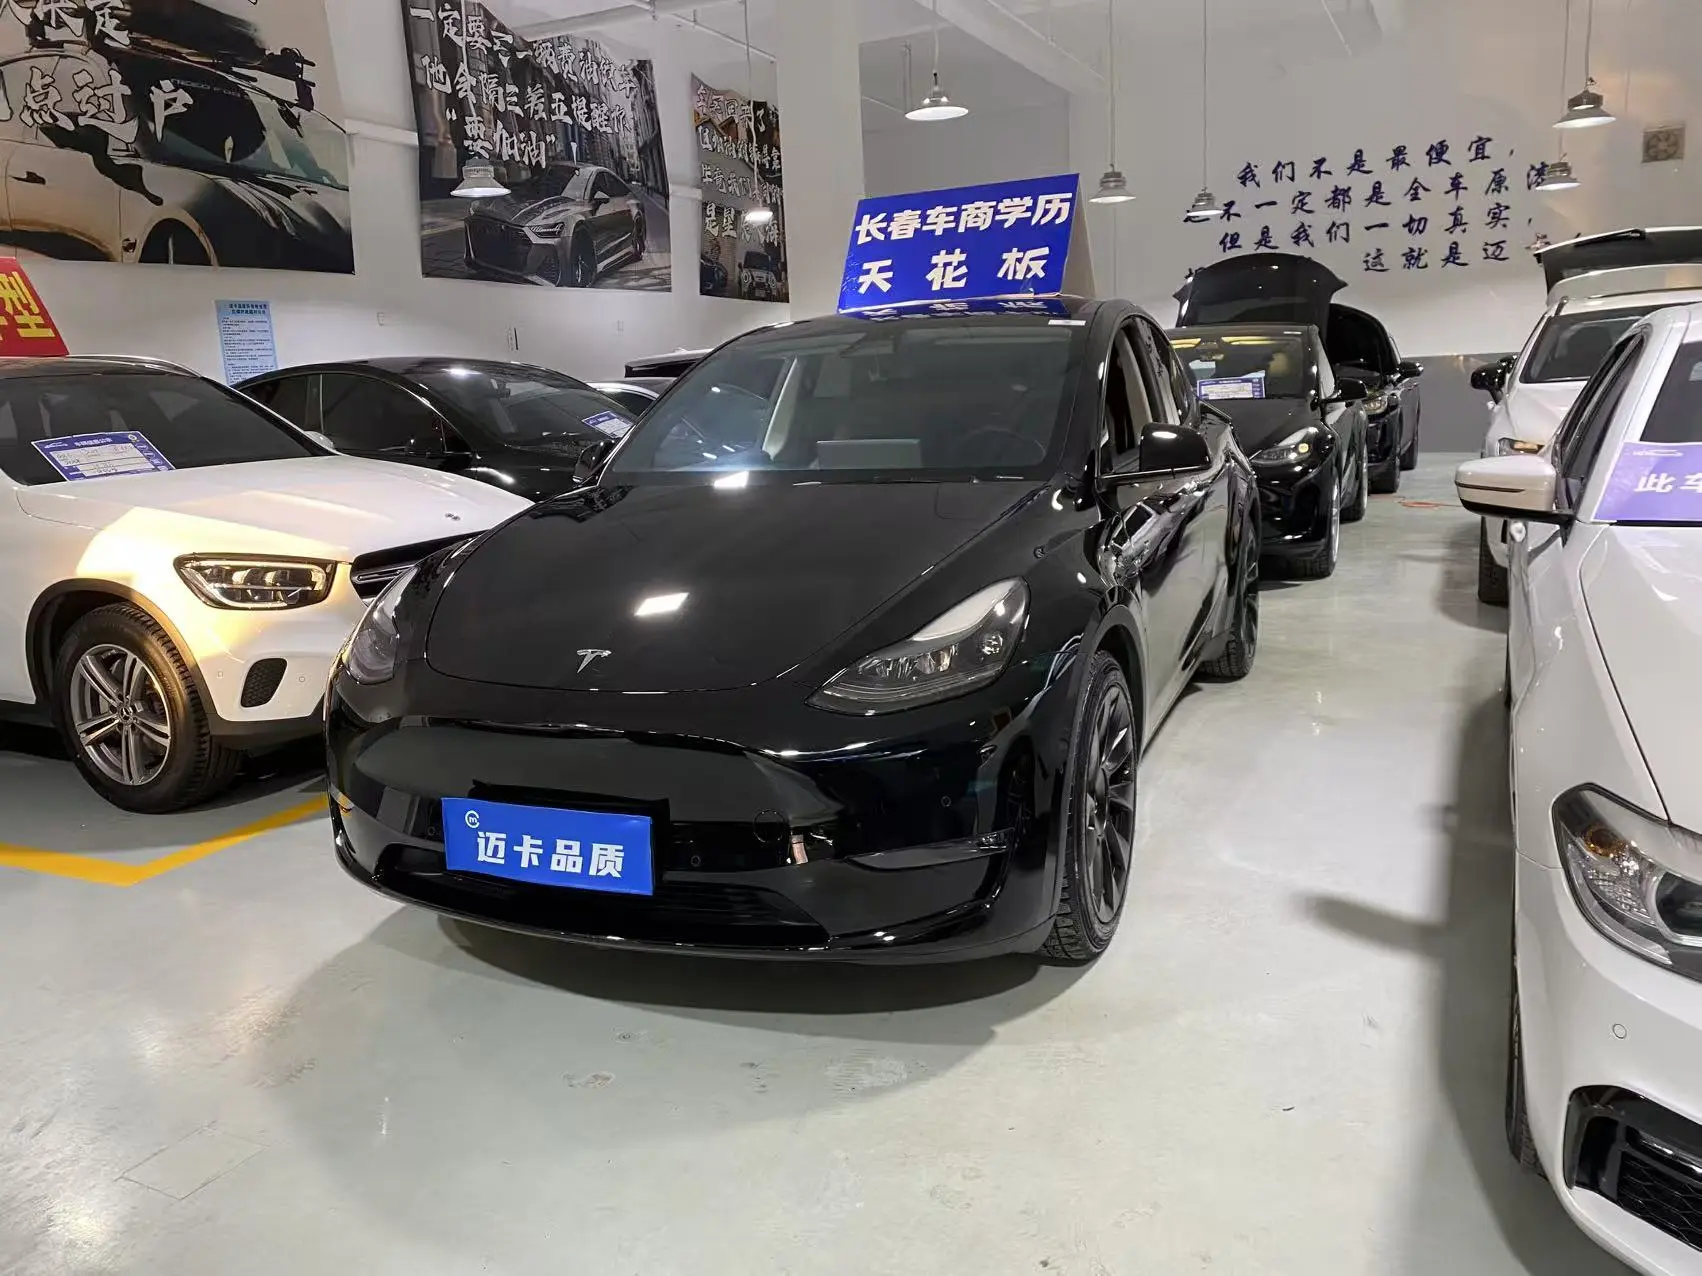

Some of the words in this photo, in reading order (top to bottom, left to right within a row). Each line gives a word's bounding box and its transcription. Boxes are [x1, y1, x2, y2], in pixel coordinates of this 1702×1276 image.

[0, 67, 193, 142] 点过户
[854, 192, 1073, 246] 长春车商学历
[857, 246, 1050, 295] 天花板
[477, 831, 625, 878] 迈卡品质
